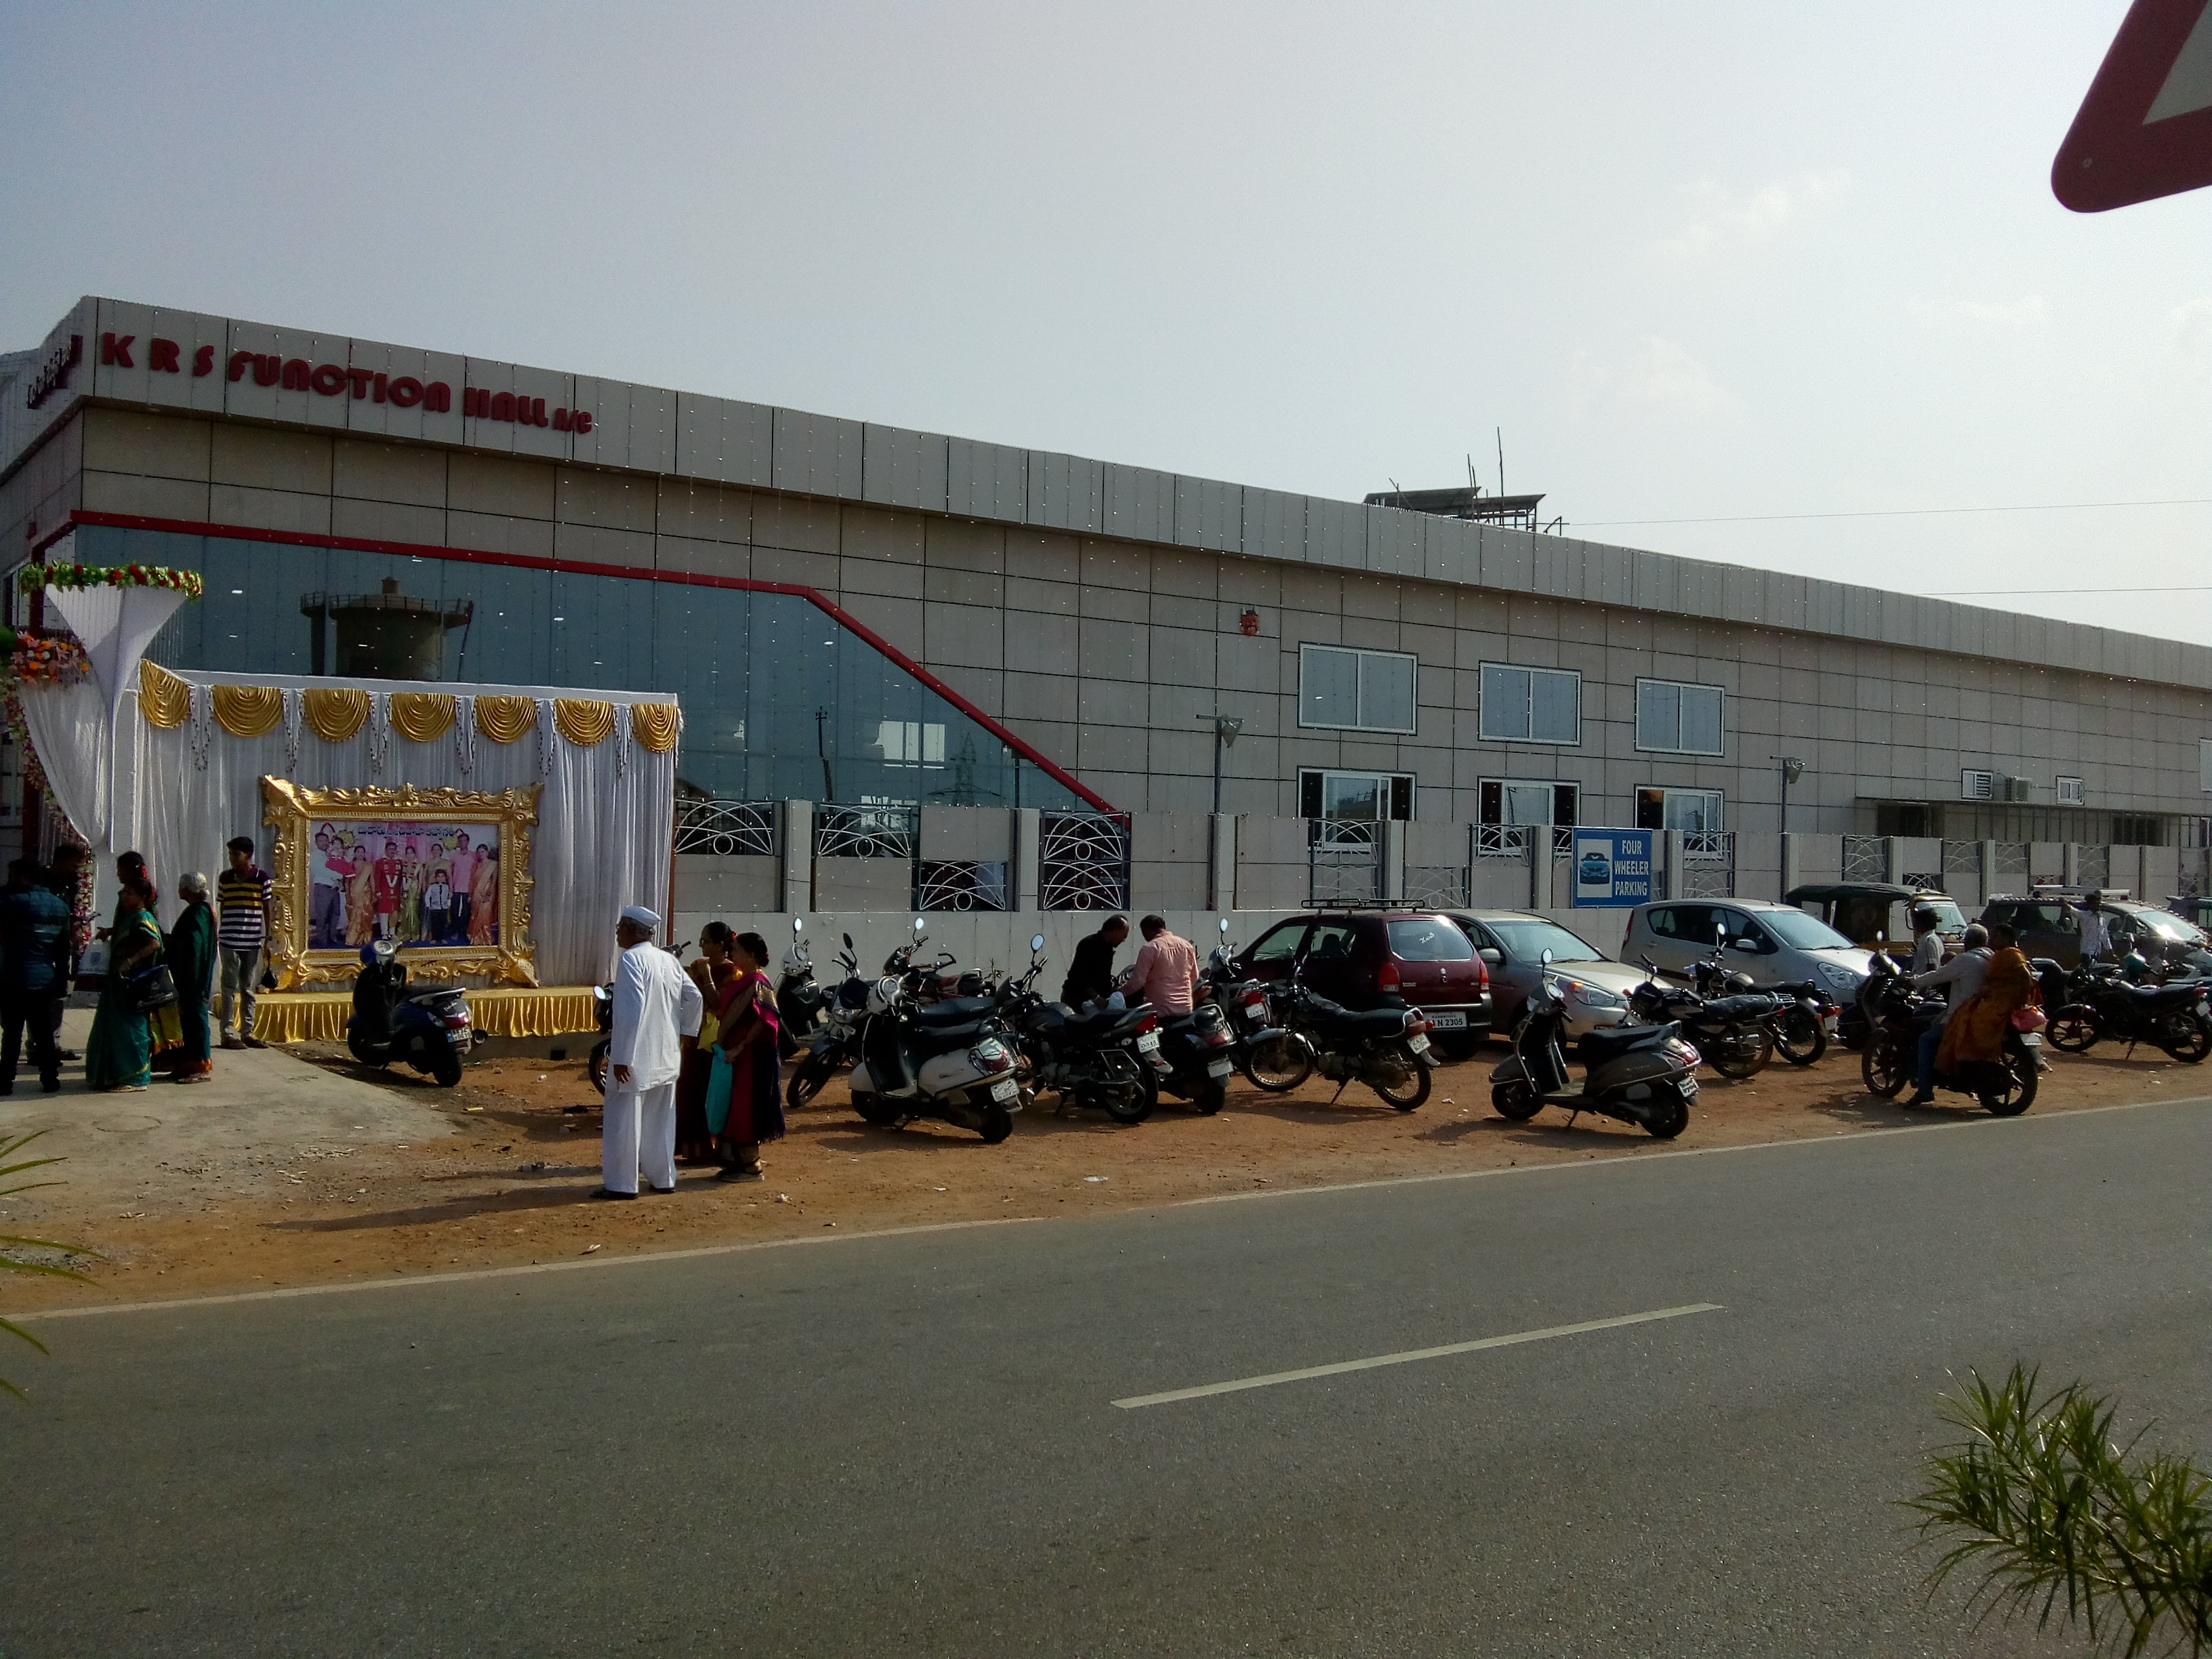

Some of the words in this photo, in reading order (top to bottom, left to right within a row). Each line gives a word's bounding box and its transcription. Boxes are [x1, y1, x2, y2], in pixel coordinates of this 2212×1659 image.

[227, 350, 451, 413] FUNCTION
[462, 386, 549, 428] HALL
[1622, 840, 1643, 855] FOUR
[1613, 860, 1650, 876] WHEELER
[1615, 881, 1647, 896] PARKING
